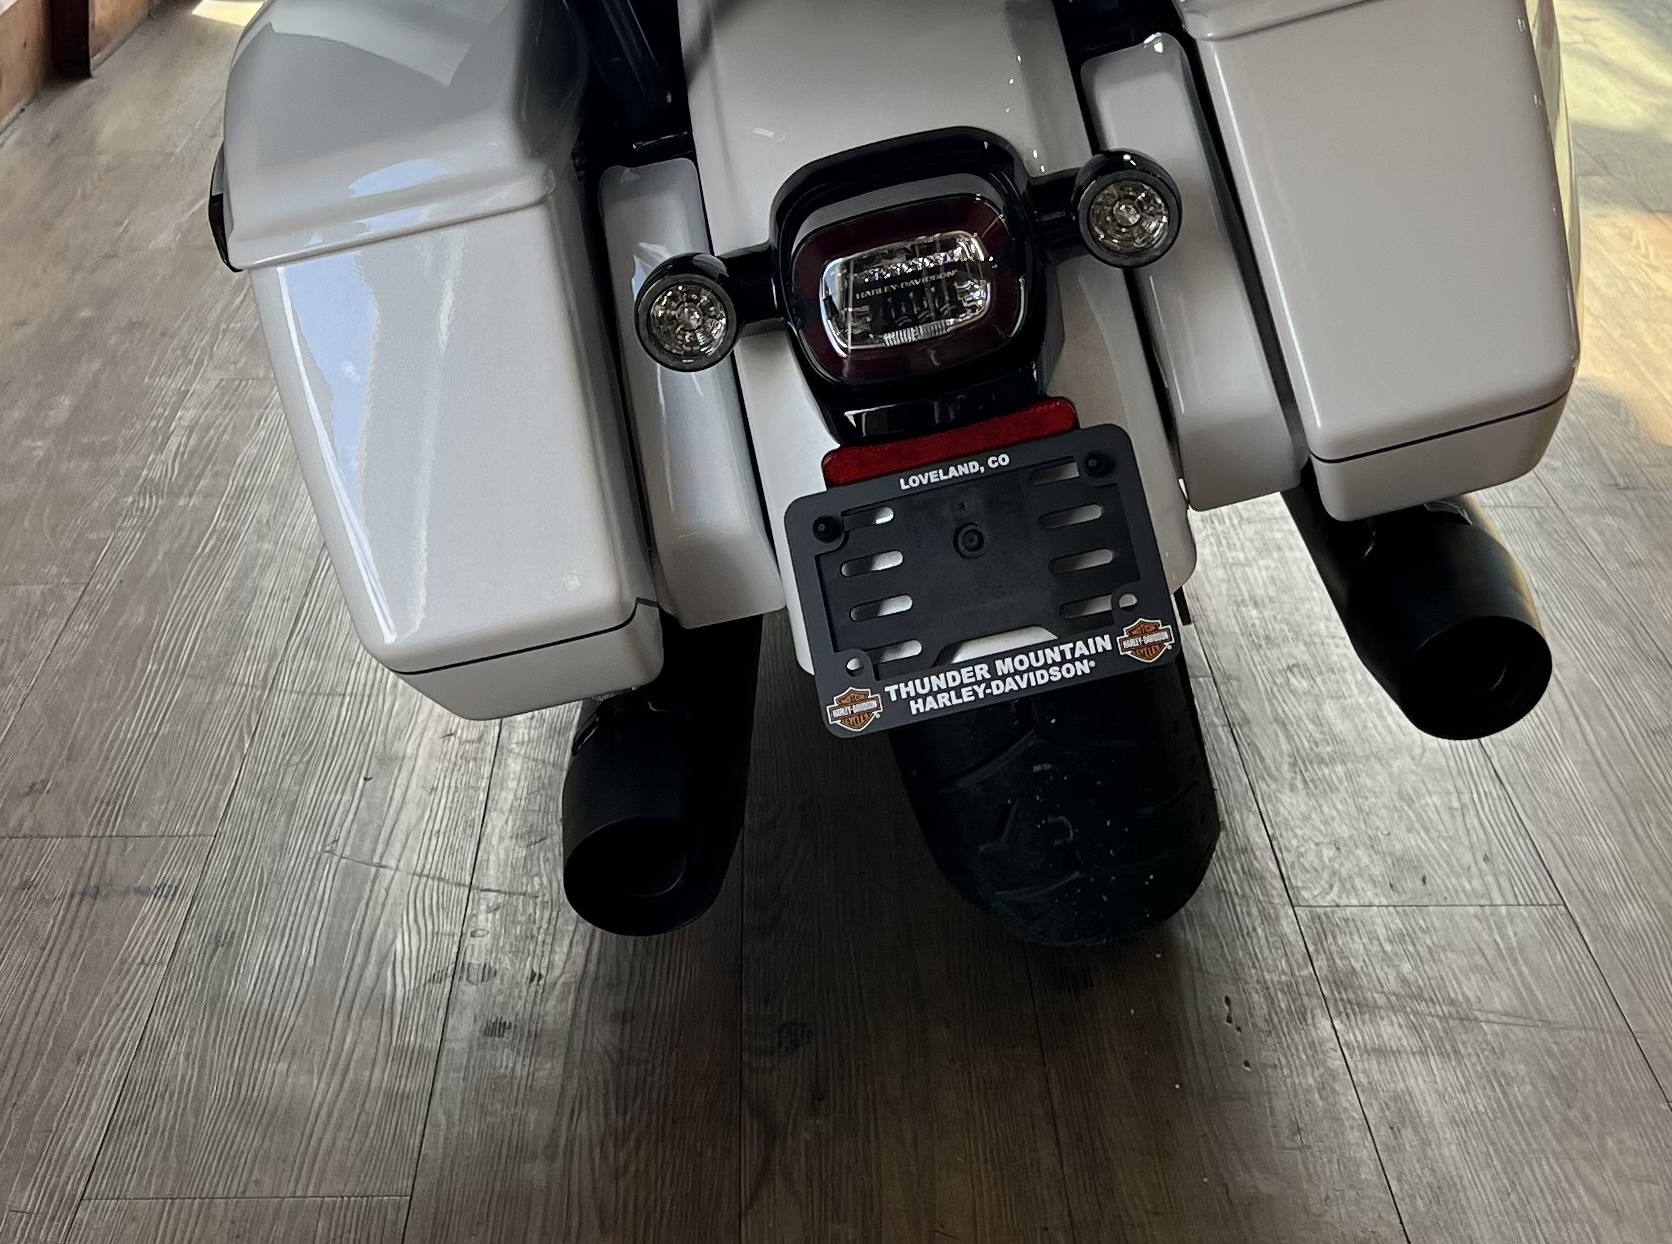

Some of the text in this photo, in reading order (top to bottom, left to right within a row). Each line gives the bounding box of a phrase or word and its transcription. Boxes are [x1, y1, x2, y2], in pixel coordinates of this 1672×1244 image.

[899, 453, 1010, 490] LOVELAND, CO
[884, 634, 1113, 702] THUNDER MOUNTAIN
